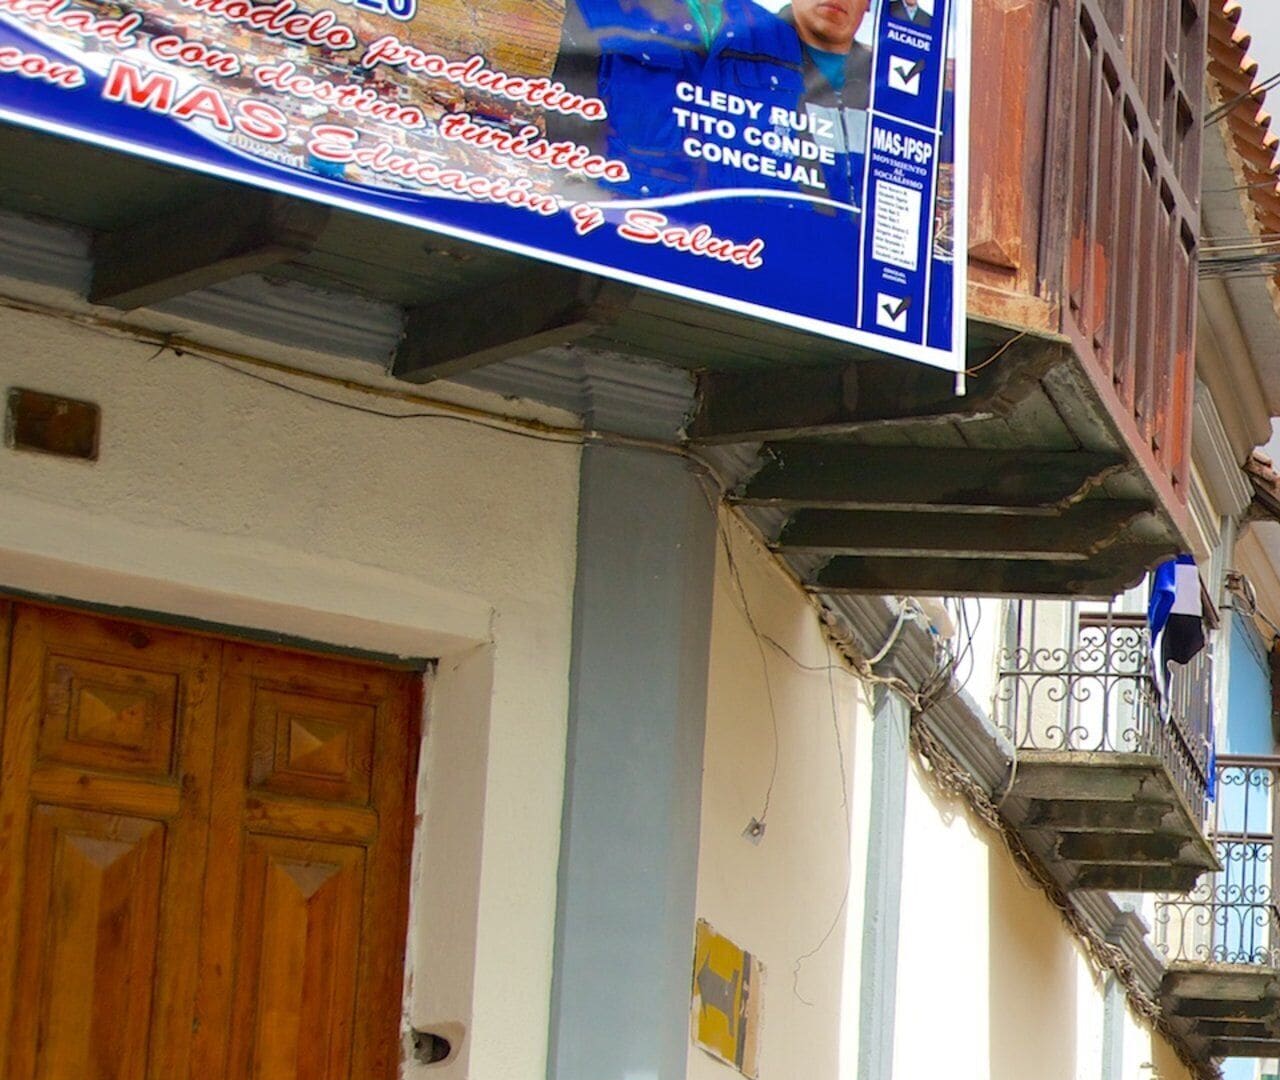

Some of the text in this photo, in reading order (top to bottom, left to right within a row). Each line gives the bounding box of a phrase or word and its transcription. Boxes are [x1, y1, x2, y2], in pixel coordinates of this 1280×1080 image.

[887, 30, 931, 52] ALCALDE
[0, 0, 630, 183] dad con destino turístico
[361, 35, 607, 121] productivo
[675, 82, 765, 119] CLEDY
[0, 47, 86, 88] con
[103, 59, 288, 143] MAS
[307, 124, 559, 216] Educación
[570, 203, 605, 237] y
[618, 210, 764, 269] Salud
[672, 107, 836, 166] TITO CONDE
[873, 127, 932, 165] MAS-IPSP
[683, 137, 827, 189] CONCEJAL
[872, 153, 927, 177] MOVIMIENTO
[873, 168, 924, 190] SOCIALISMO
